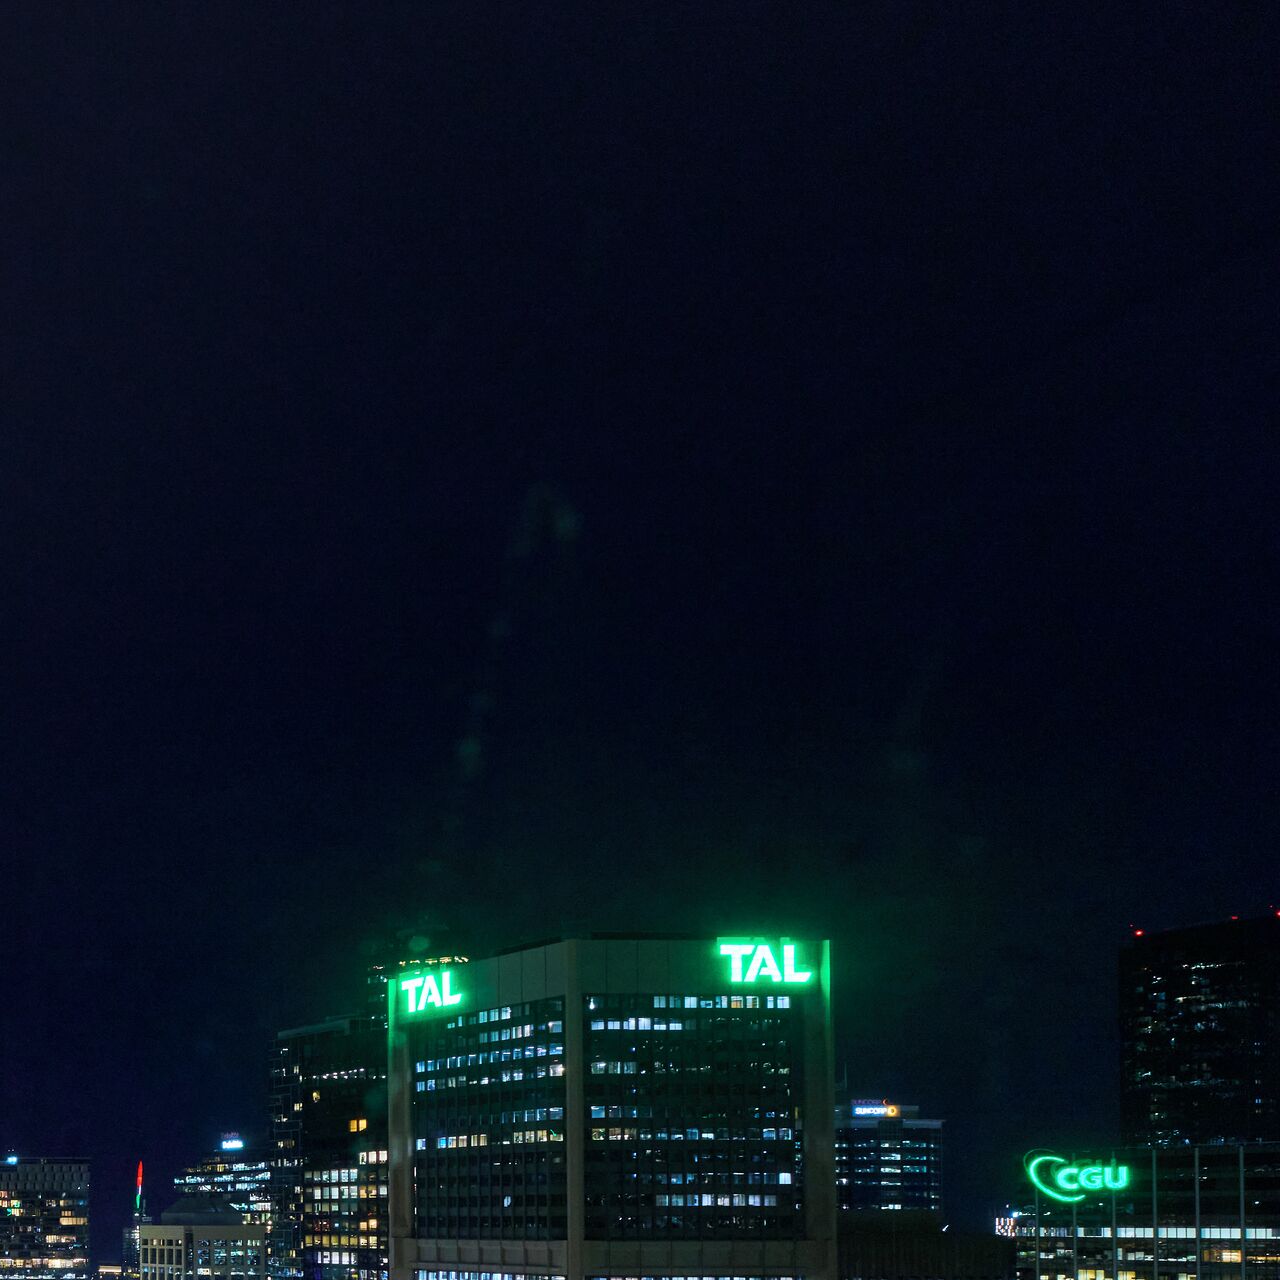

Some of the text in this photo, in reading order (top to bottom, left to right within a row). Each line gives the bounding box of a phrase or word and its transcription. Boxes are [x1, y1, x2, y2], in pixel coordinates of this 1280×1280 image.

[720, 945, 812, 983] TAL
[401, 971, 462, 1013] TAL
[855, 1107, 887, 1115] SUNCORP
[1056, 1166, 1129, 1190] CGU
